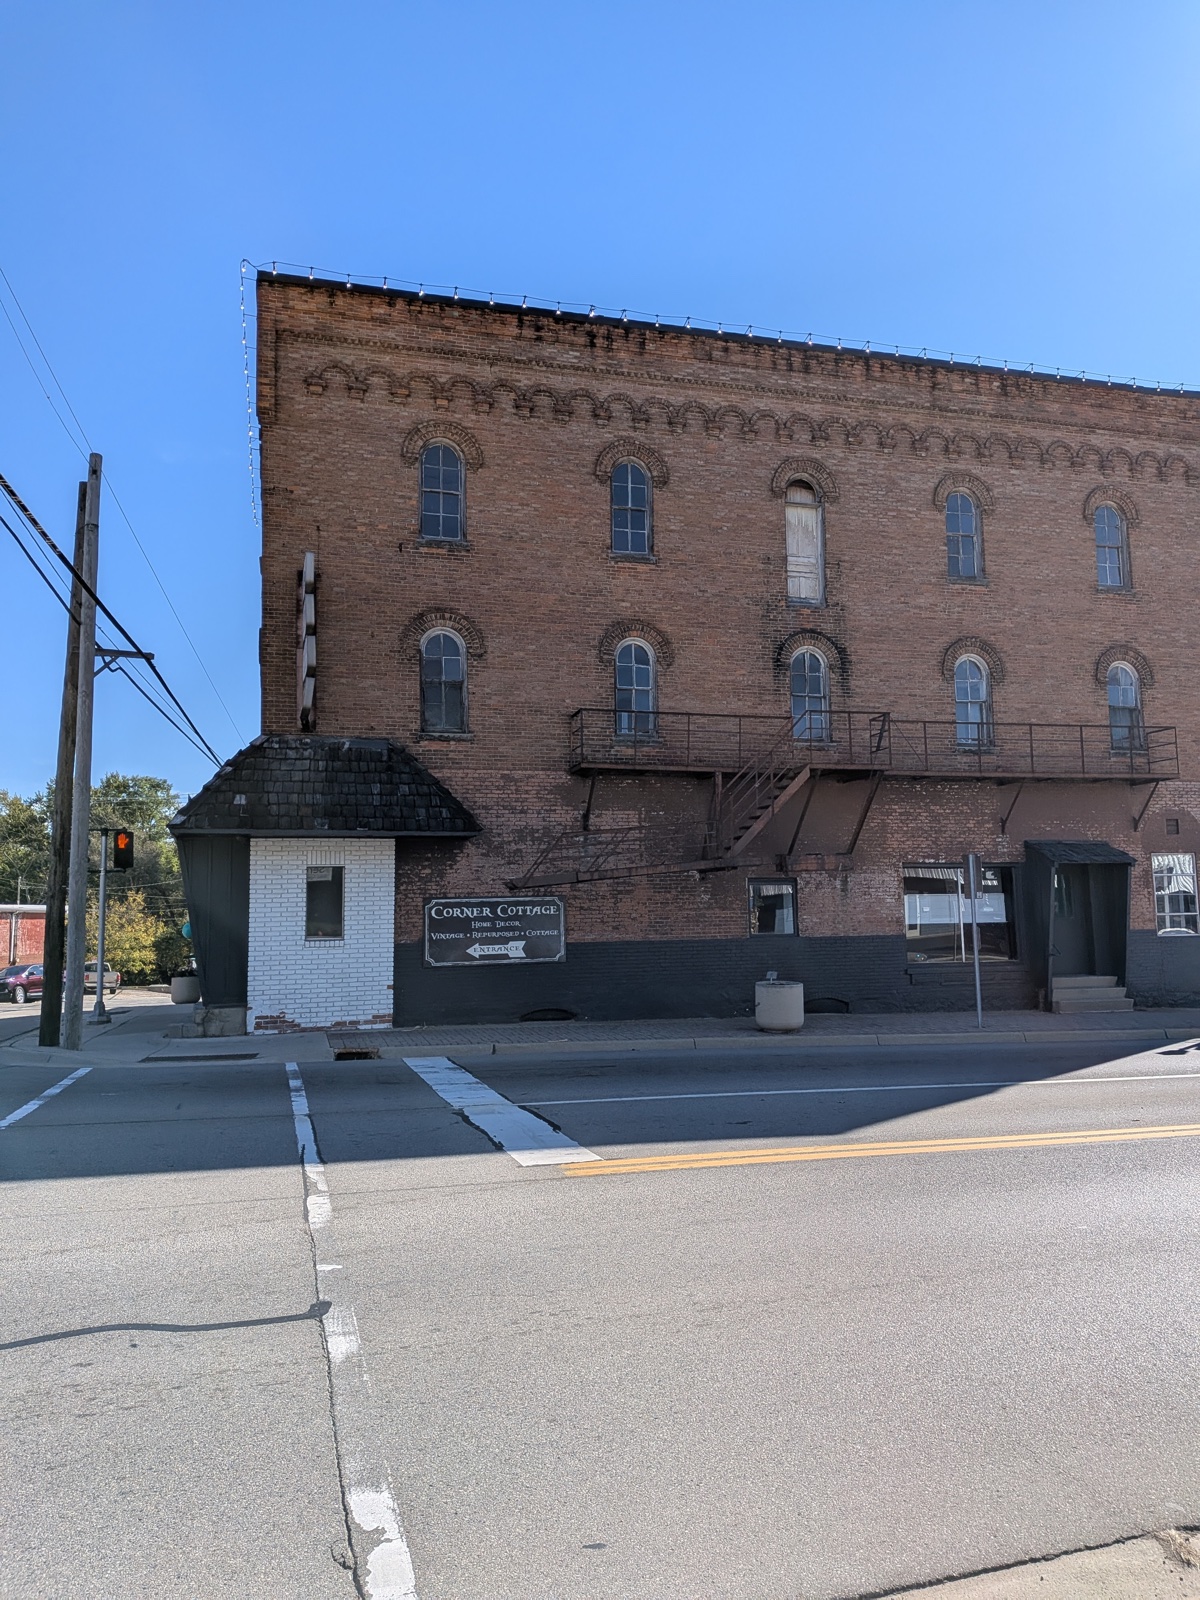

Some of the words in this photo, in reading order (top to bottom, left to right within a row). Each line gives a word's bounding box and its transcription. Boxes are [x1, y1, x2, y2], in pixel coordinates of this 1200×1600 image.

[431, 906, 494, 919] CORNER
[497, 904, 559, 917] COTTAGE
[495, 920, 521, 928] DECOR
[431, 932, 465, 940] VINTAGE
[472, 931, 520, 939] REPURPOSED
[526, 929, 559, 937] COTTAGE
[473, 945, 520, 953] ENTRANCE
